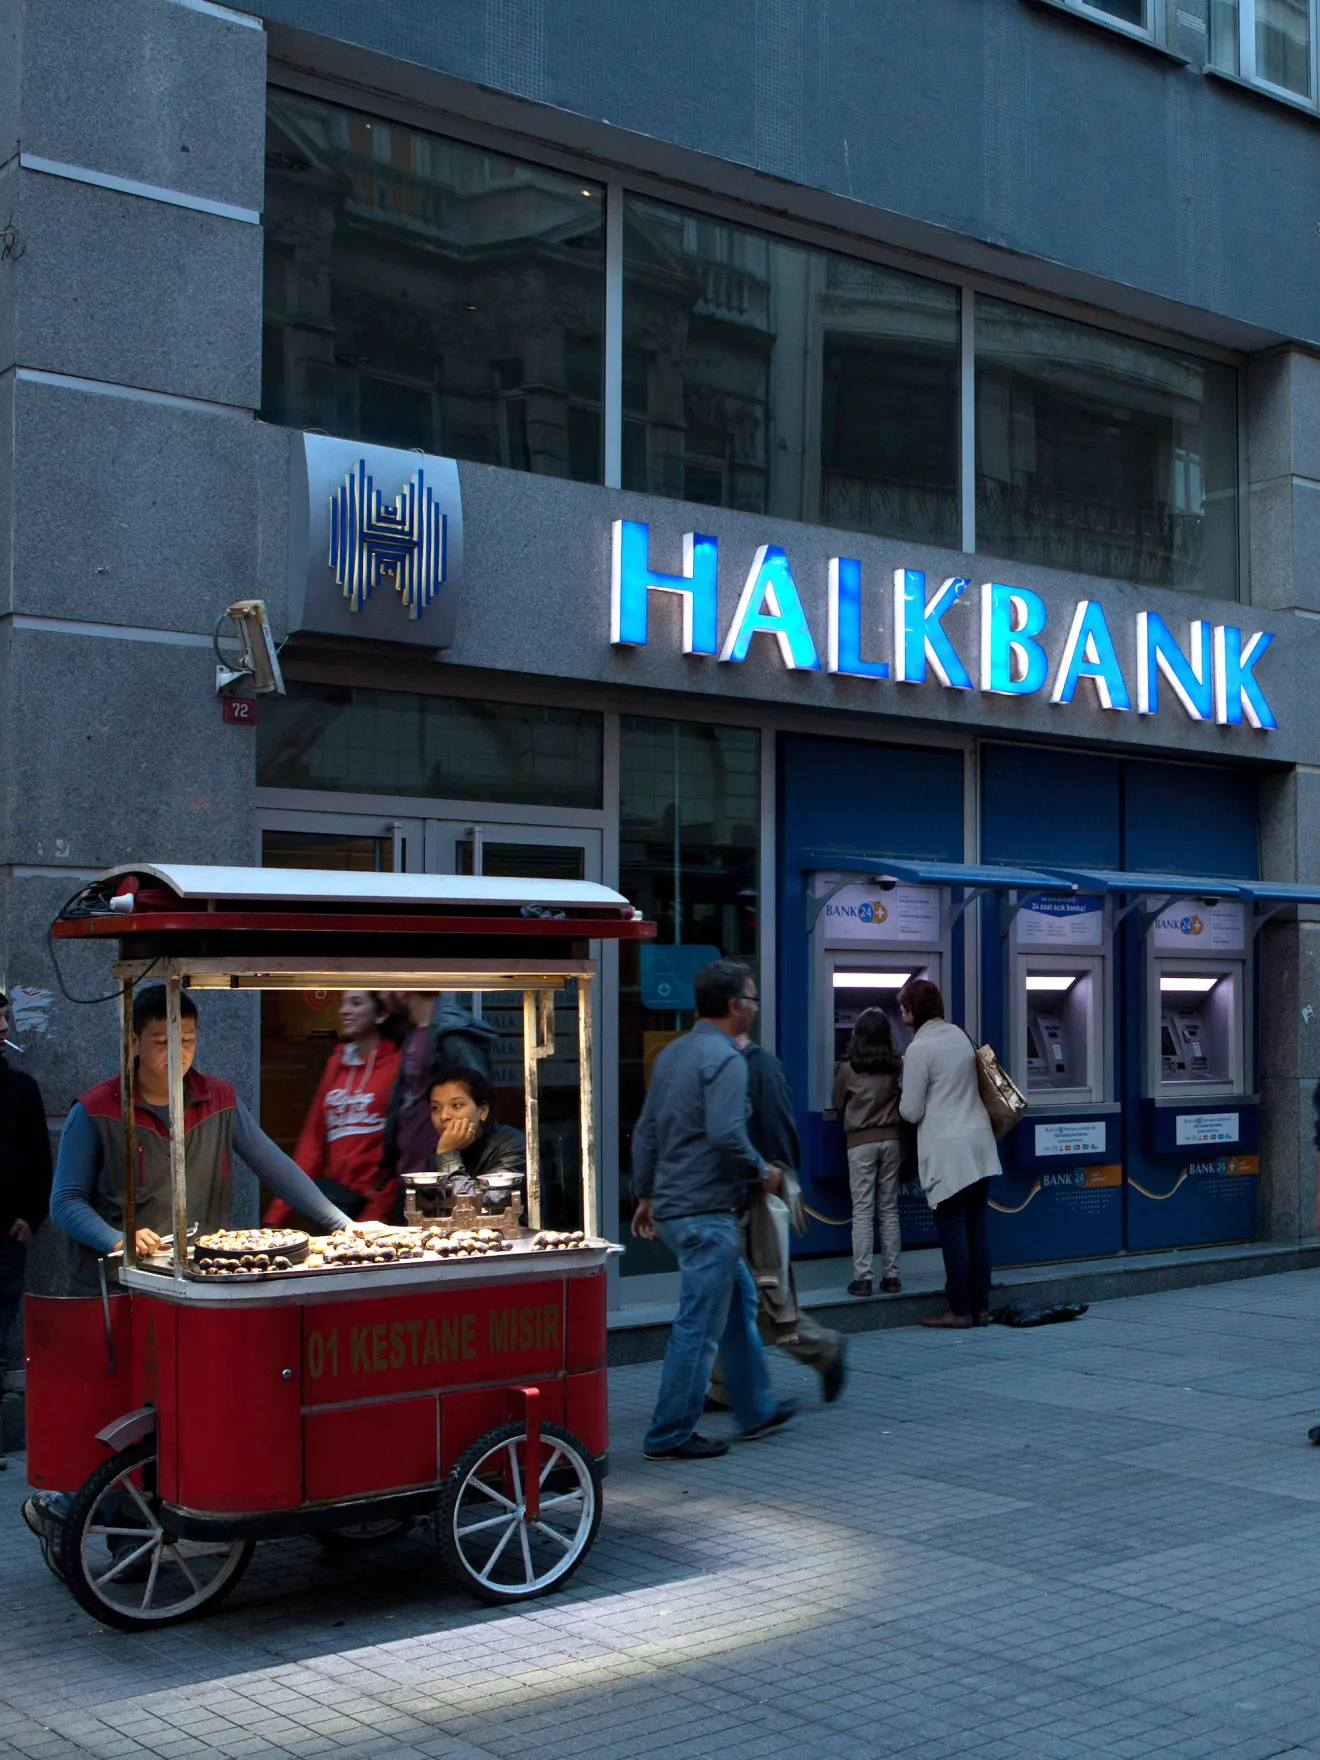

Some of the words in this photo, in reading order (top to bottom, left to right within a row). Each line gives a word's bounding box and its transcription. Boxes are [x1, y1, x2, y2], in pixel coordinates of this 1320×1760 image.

[609, 518, 1279, 731] HALKBANK
[232, 702, 249, 718] 72
[826, 904, 858, 917] BANK
[1155, 919, 1179, 930] BANK
[1189, 1163, 1215, 1175] BANK
[1043, 1173, 1072, 1187] BANK
[308, 1329, 338, 1379] 01
[351, 1314, 476, 1374] KESTANE
[489, 1304, 560, 1354] MISIR
